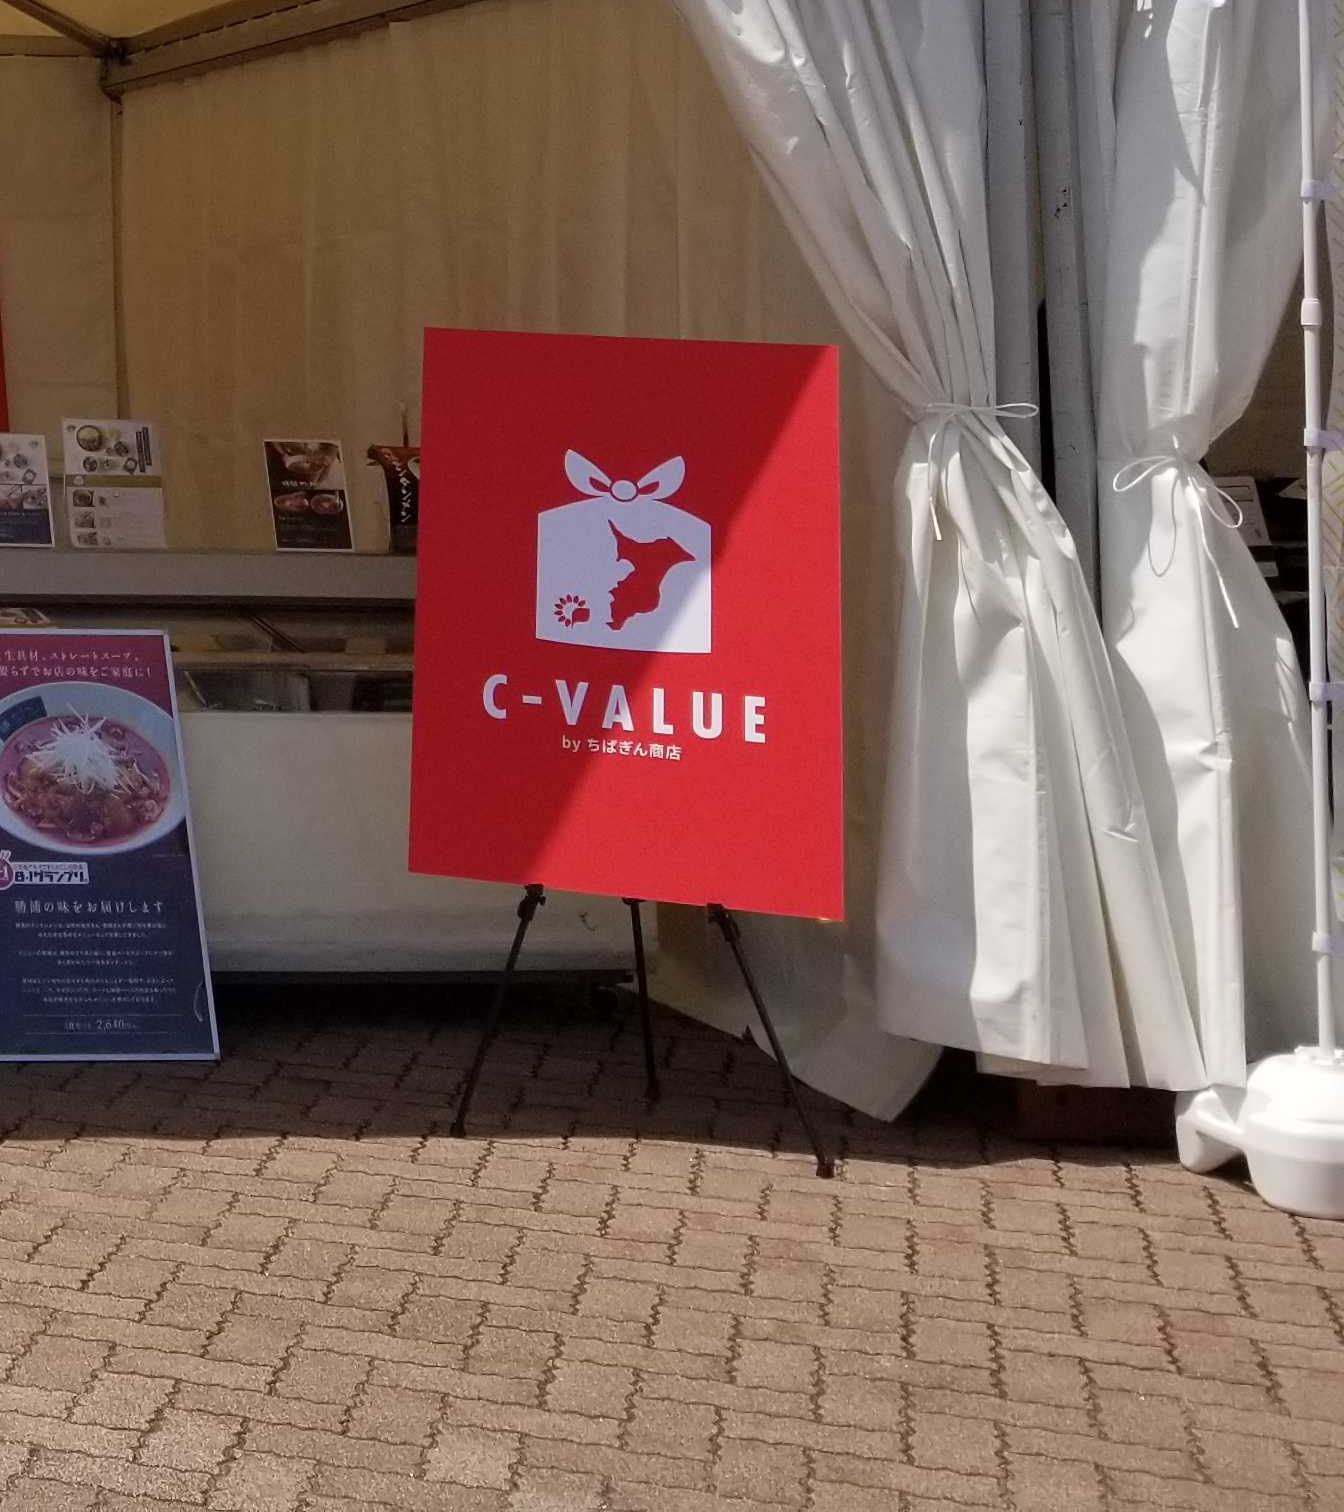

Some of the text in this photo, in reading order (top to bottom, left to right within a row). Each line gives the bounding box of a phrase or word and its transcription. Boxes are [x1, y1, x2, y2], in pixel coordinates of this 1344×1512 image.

[482, 674, 766, 743] C-VALUE
[562, 735, 681, 761] by ちばぎん商店
